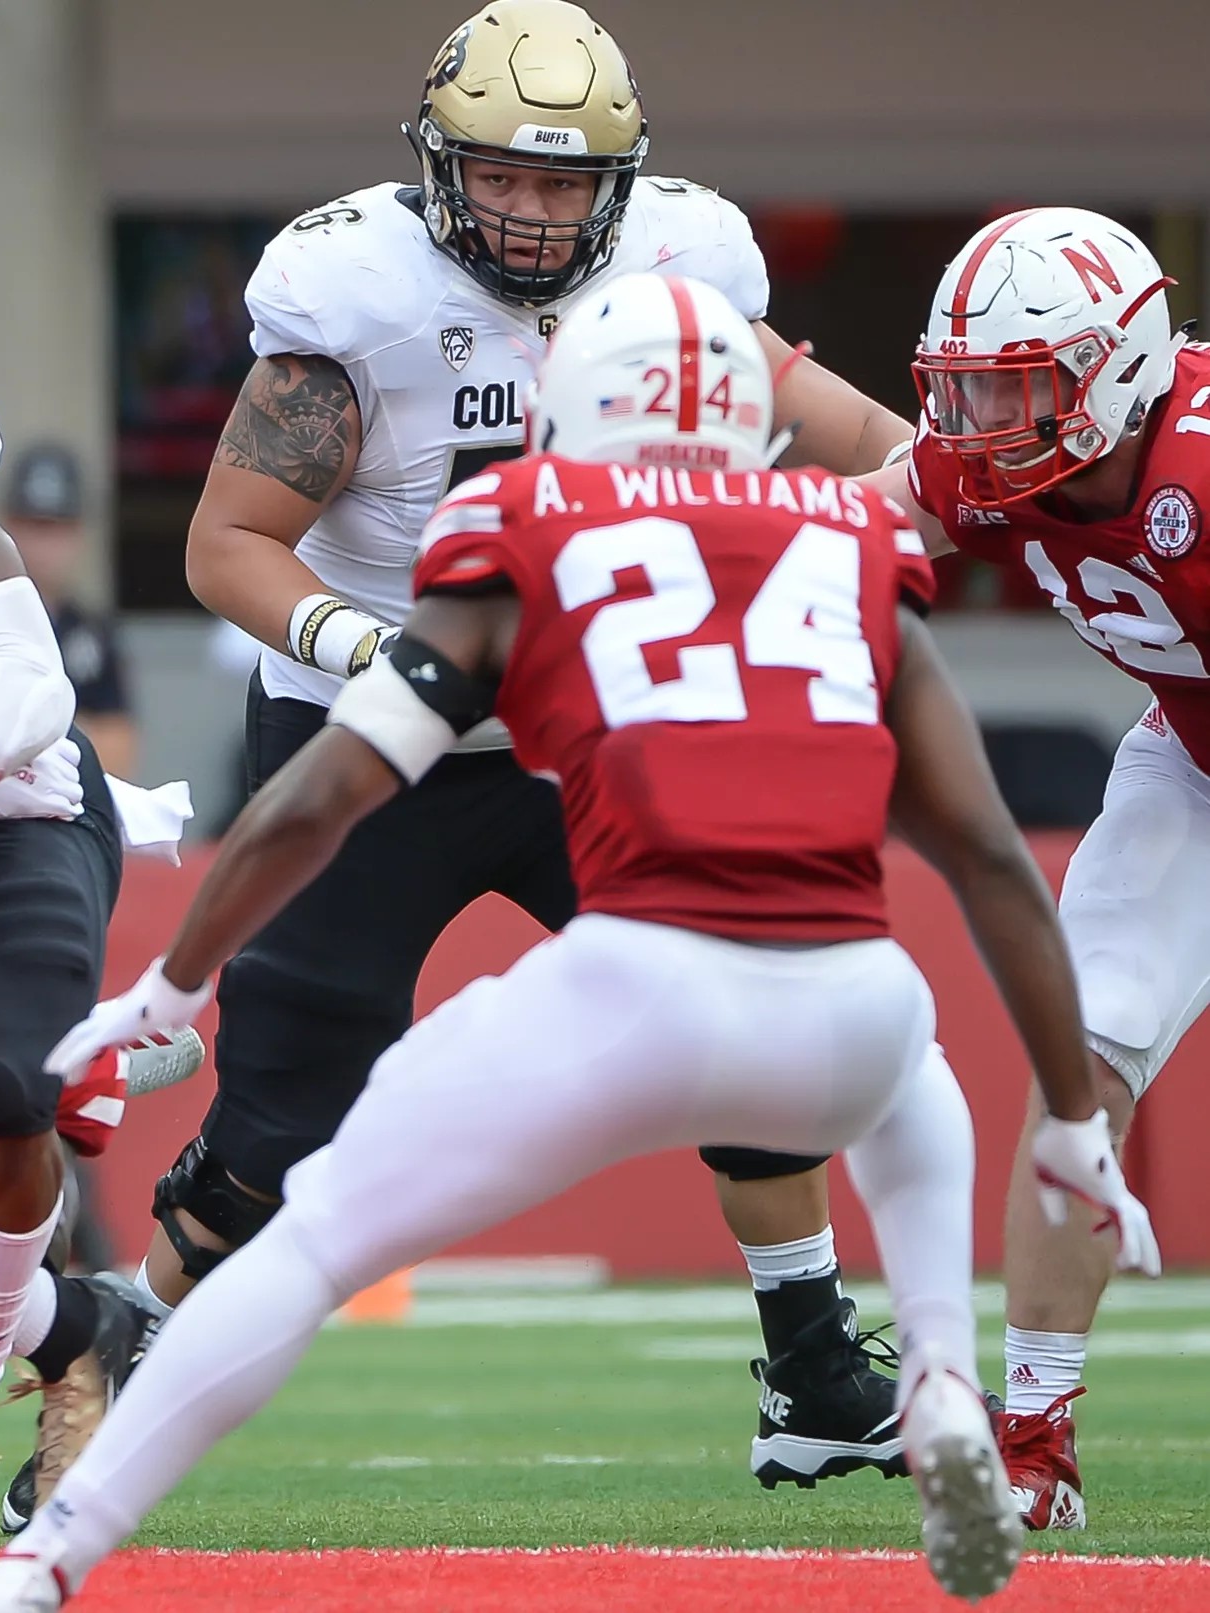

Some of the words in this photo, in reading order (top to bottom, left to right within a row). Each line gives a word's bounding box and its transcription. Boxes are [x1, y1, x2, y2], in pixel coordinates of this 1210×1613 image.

[534, 130, 569, 145] BUFFS
[1060, 239, 1123, 304] N
[441, 326, 473, 353] PAC
[450, 344, 466, 361] 12
[940, 339, 968, 354] 402
[643, 367, 732, 419] 24
[534, 461, 584, 517] A.
[608, 463, 868, 528] WILLIAMS
[551, 515, 879, 730] 24
[1025, 540, 1210, 678] 12
